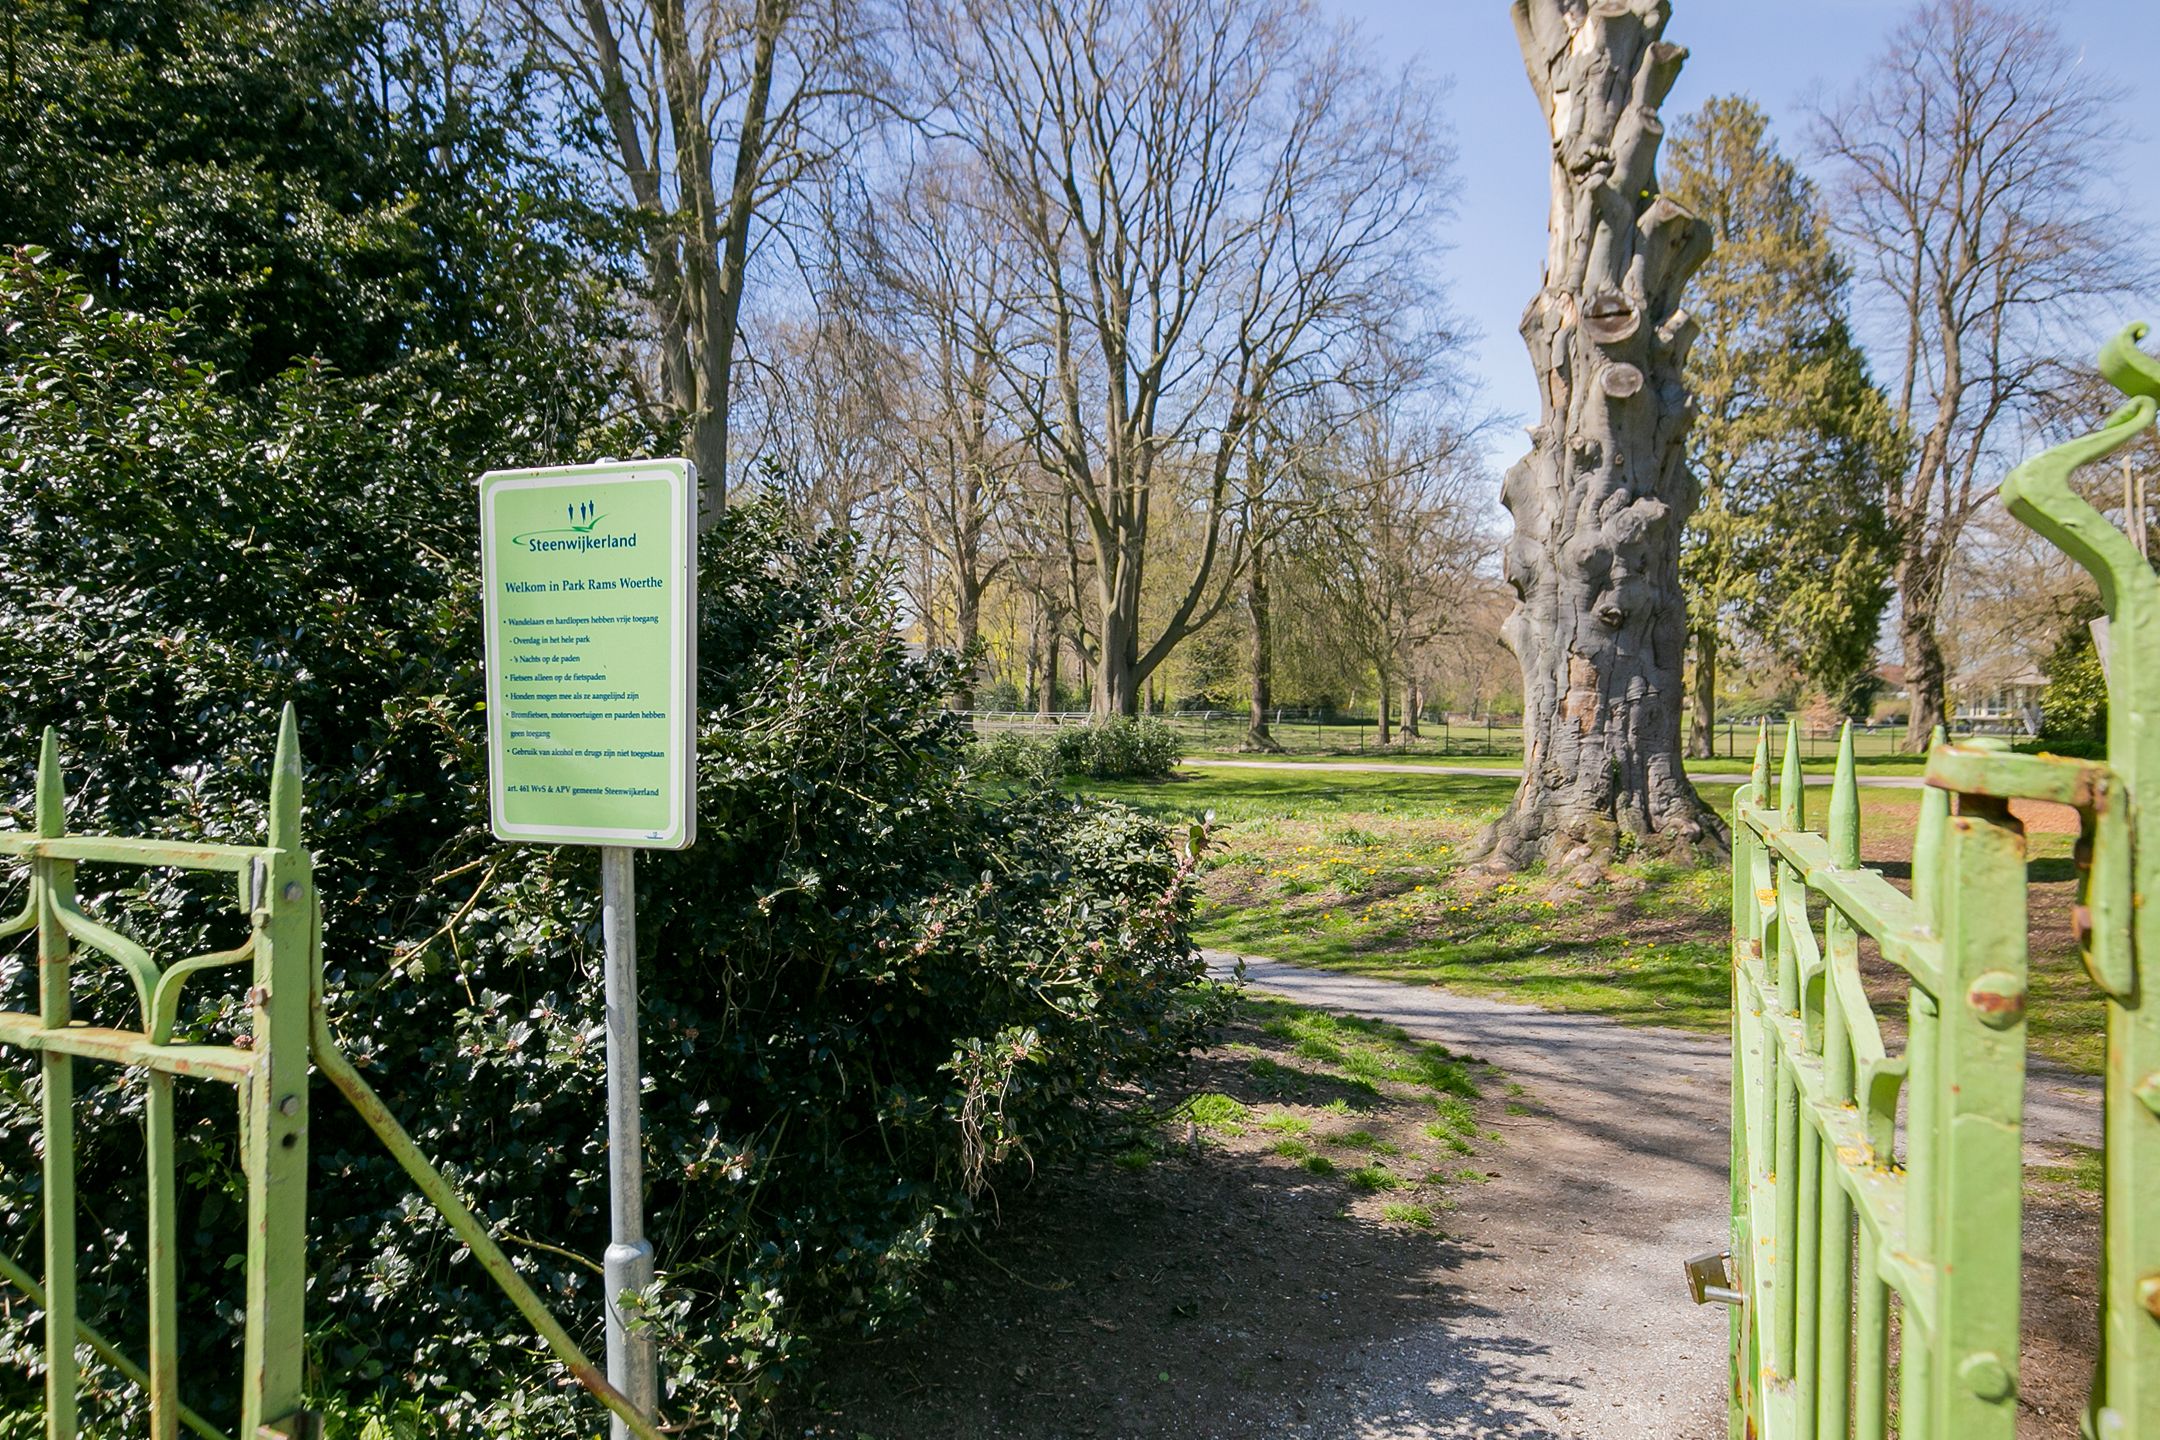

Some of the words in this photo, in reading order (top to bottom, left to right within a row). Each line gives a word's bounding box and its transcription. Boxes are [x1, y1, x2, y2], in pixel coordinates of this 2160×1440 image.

[529, 533, 637, 553] Steenwijkerland
[505, 581, 546, 593] Welkom
[550, 581, 560, 592] in
[562, 579, 585, 591] Park
[588, 578, 617, 590] Rams
[620, 576, 663, 588] Woerthe
[508, 618, 544, 626] Wandelaars
[556, 616, 590, 626] hardlopers
[591, 616, 614, 624] hebben
[616, 615, 631, 624] vrije
[632, 616, 658, 624] toegang
[513, 636, 541, 646] Overdag
[576, 635, 591, 645] park
[560, 654, 580, 664] paden
[573, 673, 606, 683] fietspaden
[536, 694, 557, 702] mogen
[592, 692, 625, 702] aangelijnd
[626, 692, 639, 701] zijn
[510, 711, 550, 719] Bromfietsen,
[551, 711, 604, 720] motorvoertuigen
[614, 711, 640, 720] paarden
[584, 749, 602, 758] drugs
[604, 749, 615, 758] zijn
[631, 750, 664, 759] toegestaan
[572, 788, 603, 796] gemeente
[604, 787, 659, 797] Steenwijkerland
